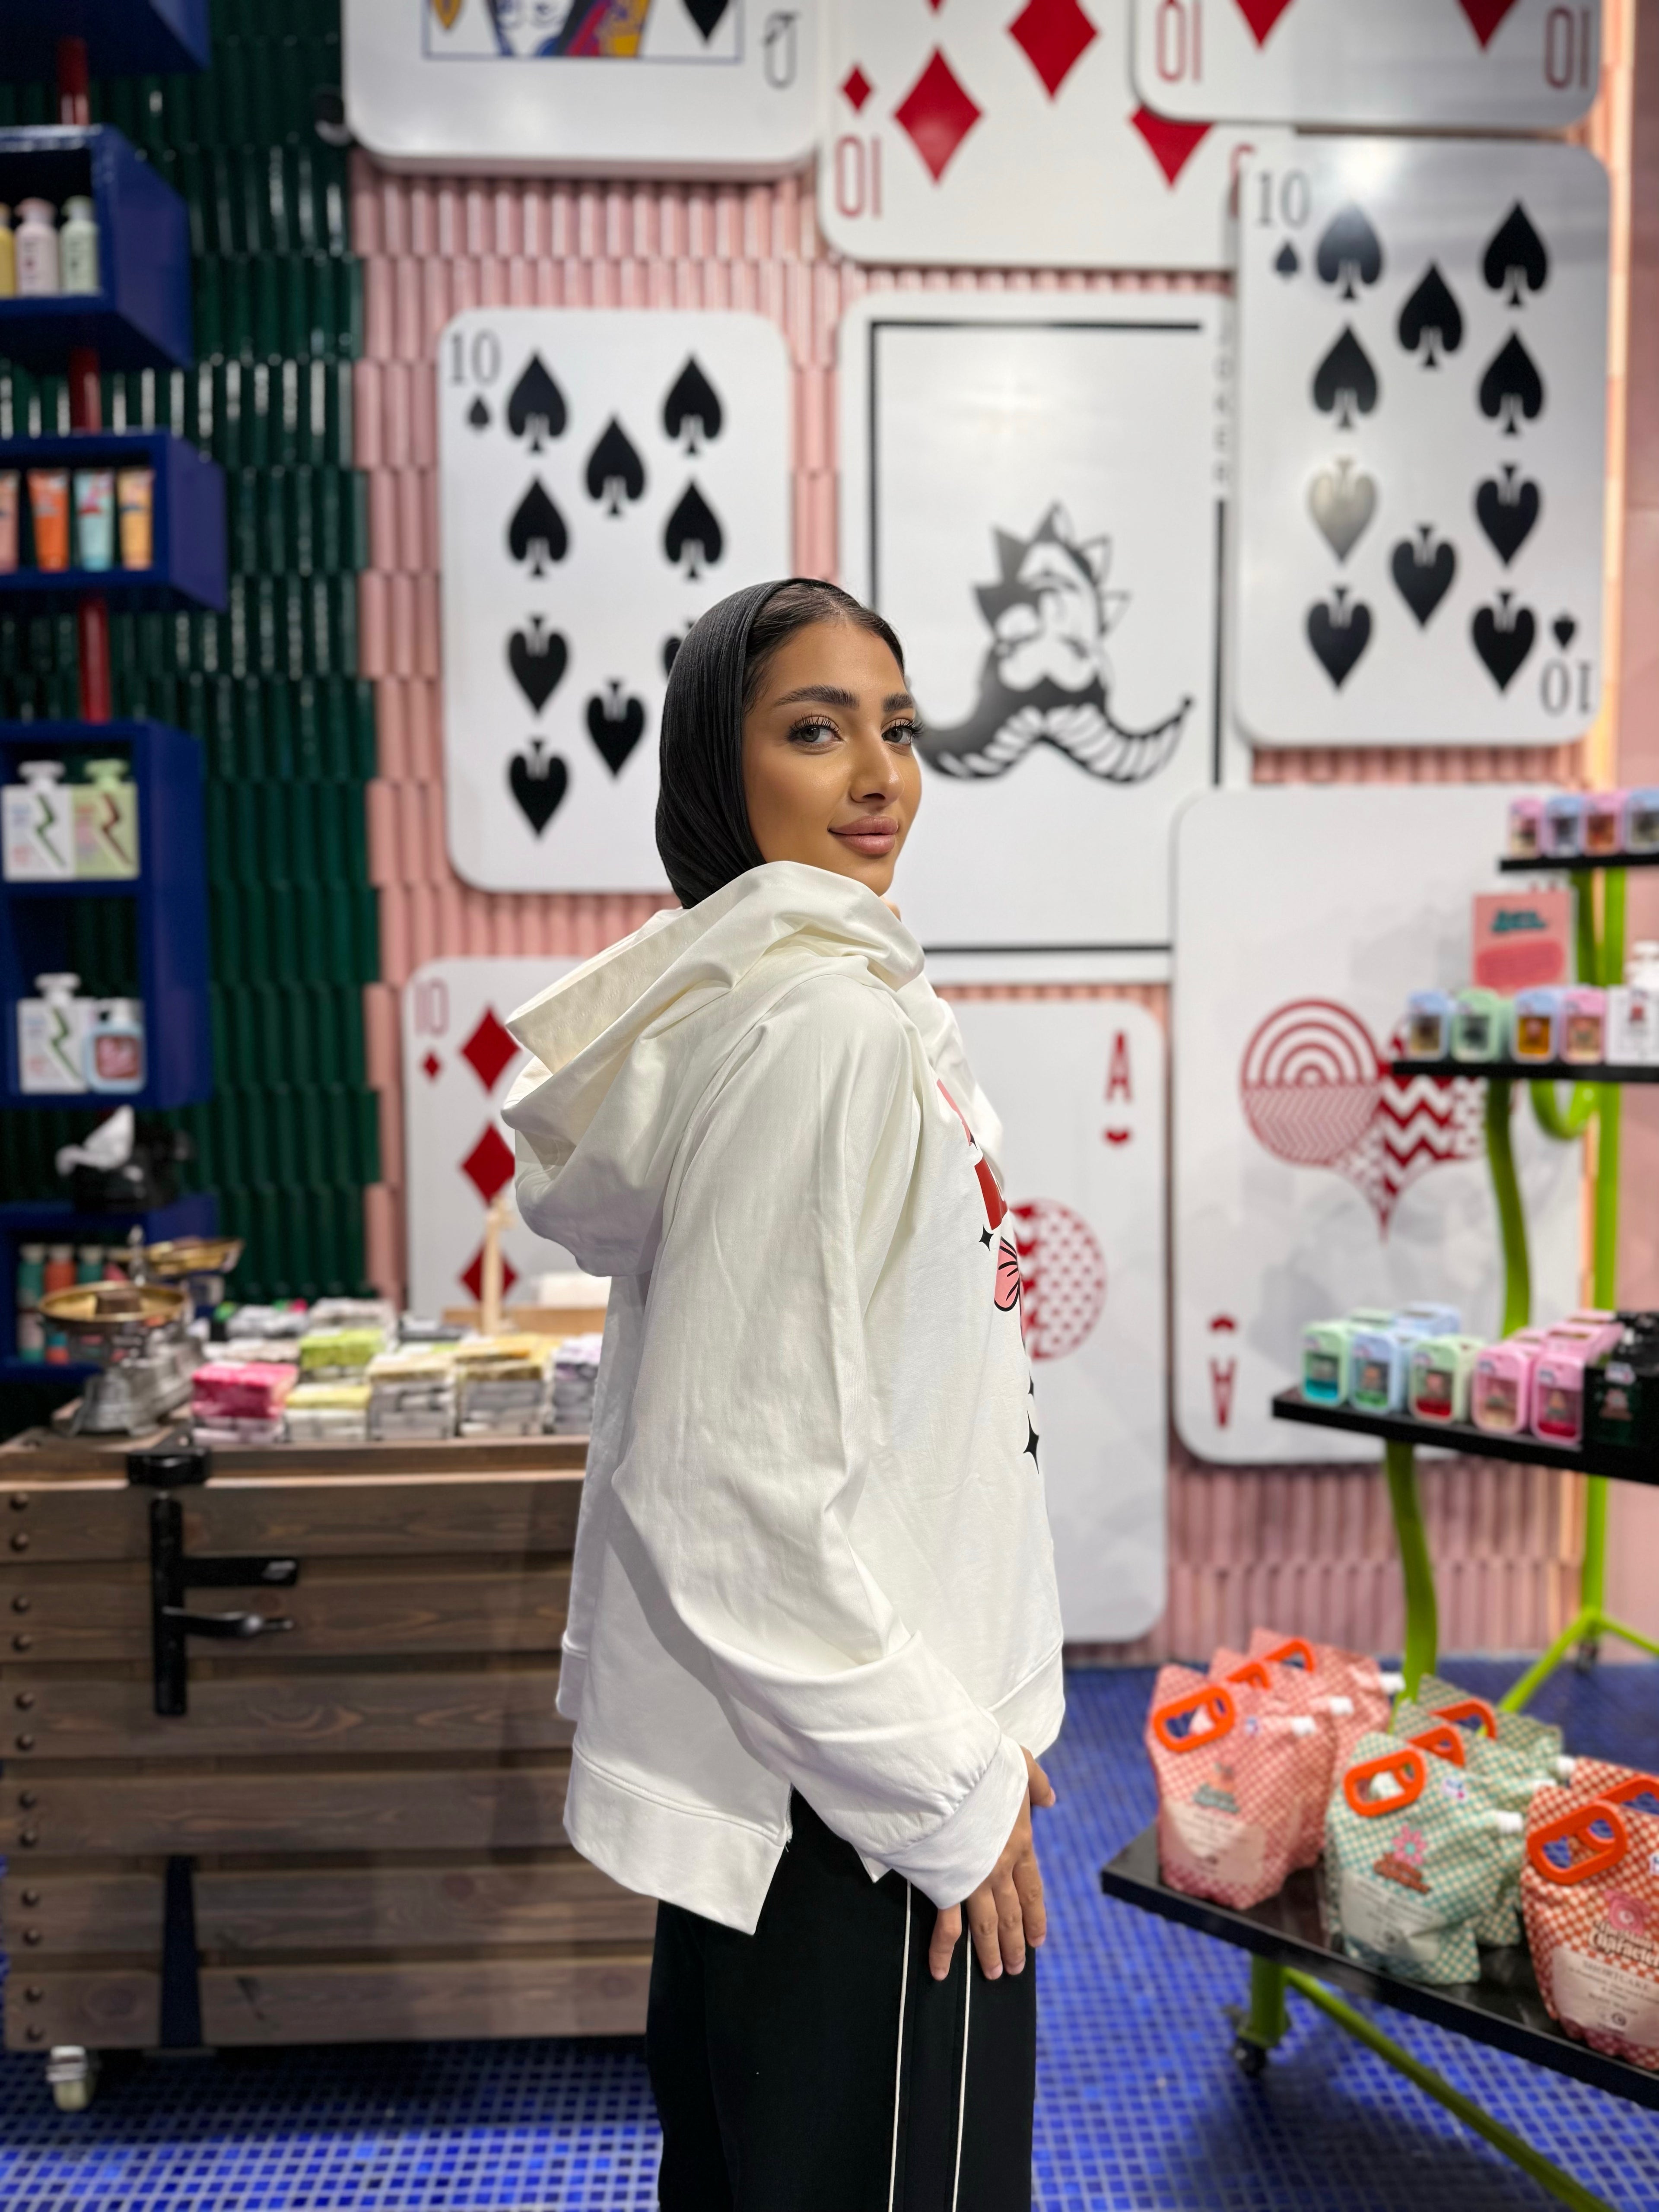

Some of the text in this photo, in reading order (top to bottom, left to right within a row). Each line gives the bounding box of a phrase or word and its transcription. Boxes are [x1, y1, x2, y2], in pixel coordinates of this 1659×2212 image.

[1156, 0, 1201, 82] 10
[1545, 6, 1591, 90] 10
[835, 135, 882, 219] 10
[1255, 171, 1312, 229] 10
[451, 329, 501, 385] 10
[1539, 658, 1592, 717] 10
[415, 978, 449, 1036] 10
[1104, 1030, 1133, 1103] A
[1208, 1356, 1237, 1429] A
